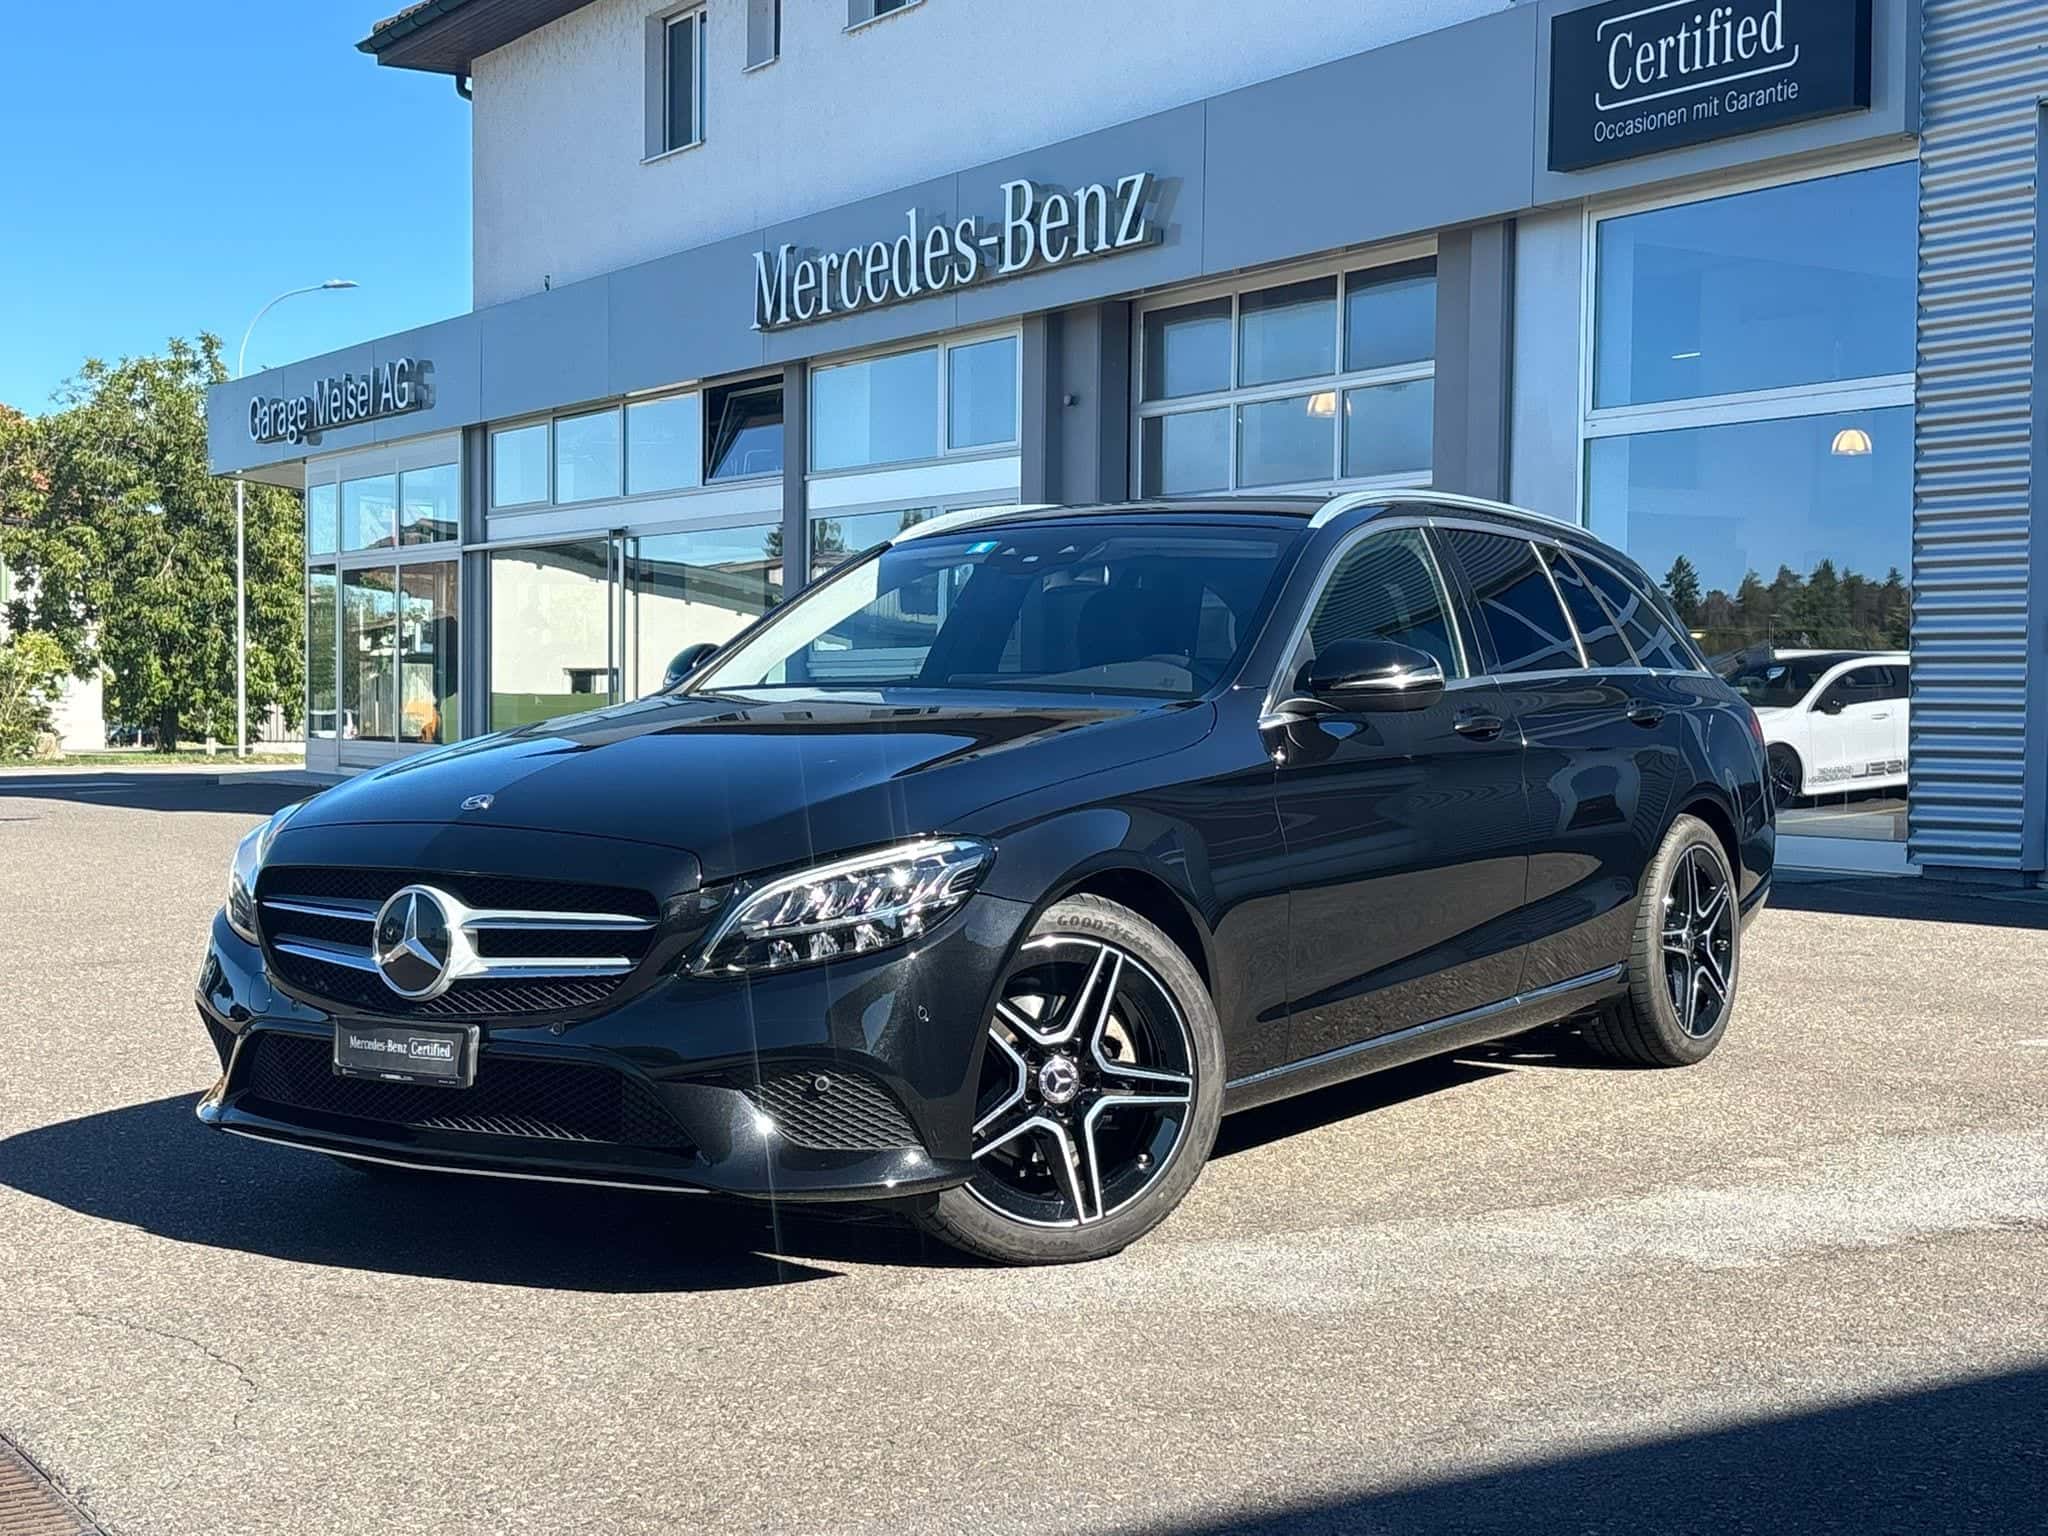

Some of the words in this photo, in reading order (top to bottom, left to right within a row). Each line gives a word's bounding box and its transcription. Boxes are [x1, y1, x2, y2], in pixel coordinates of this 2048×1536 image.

[1608, 0, 1785, 91] Certified
[1594, 105, 1687, 143] Occasionen
[1693, 95, 1720, 120] mit
[1725, 78, 1799, 114] Garantie
[750, 172, 1148, 331] Mercedes-Benz
[248, 396, 308, 445] Garage
[313, 366, 375, 427] Meisel
[379, 358, 409, 413] AG
[349, 1035, 408, 1054] Mercedes-Benz
[411, 1042, 451, 1058] Certified
